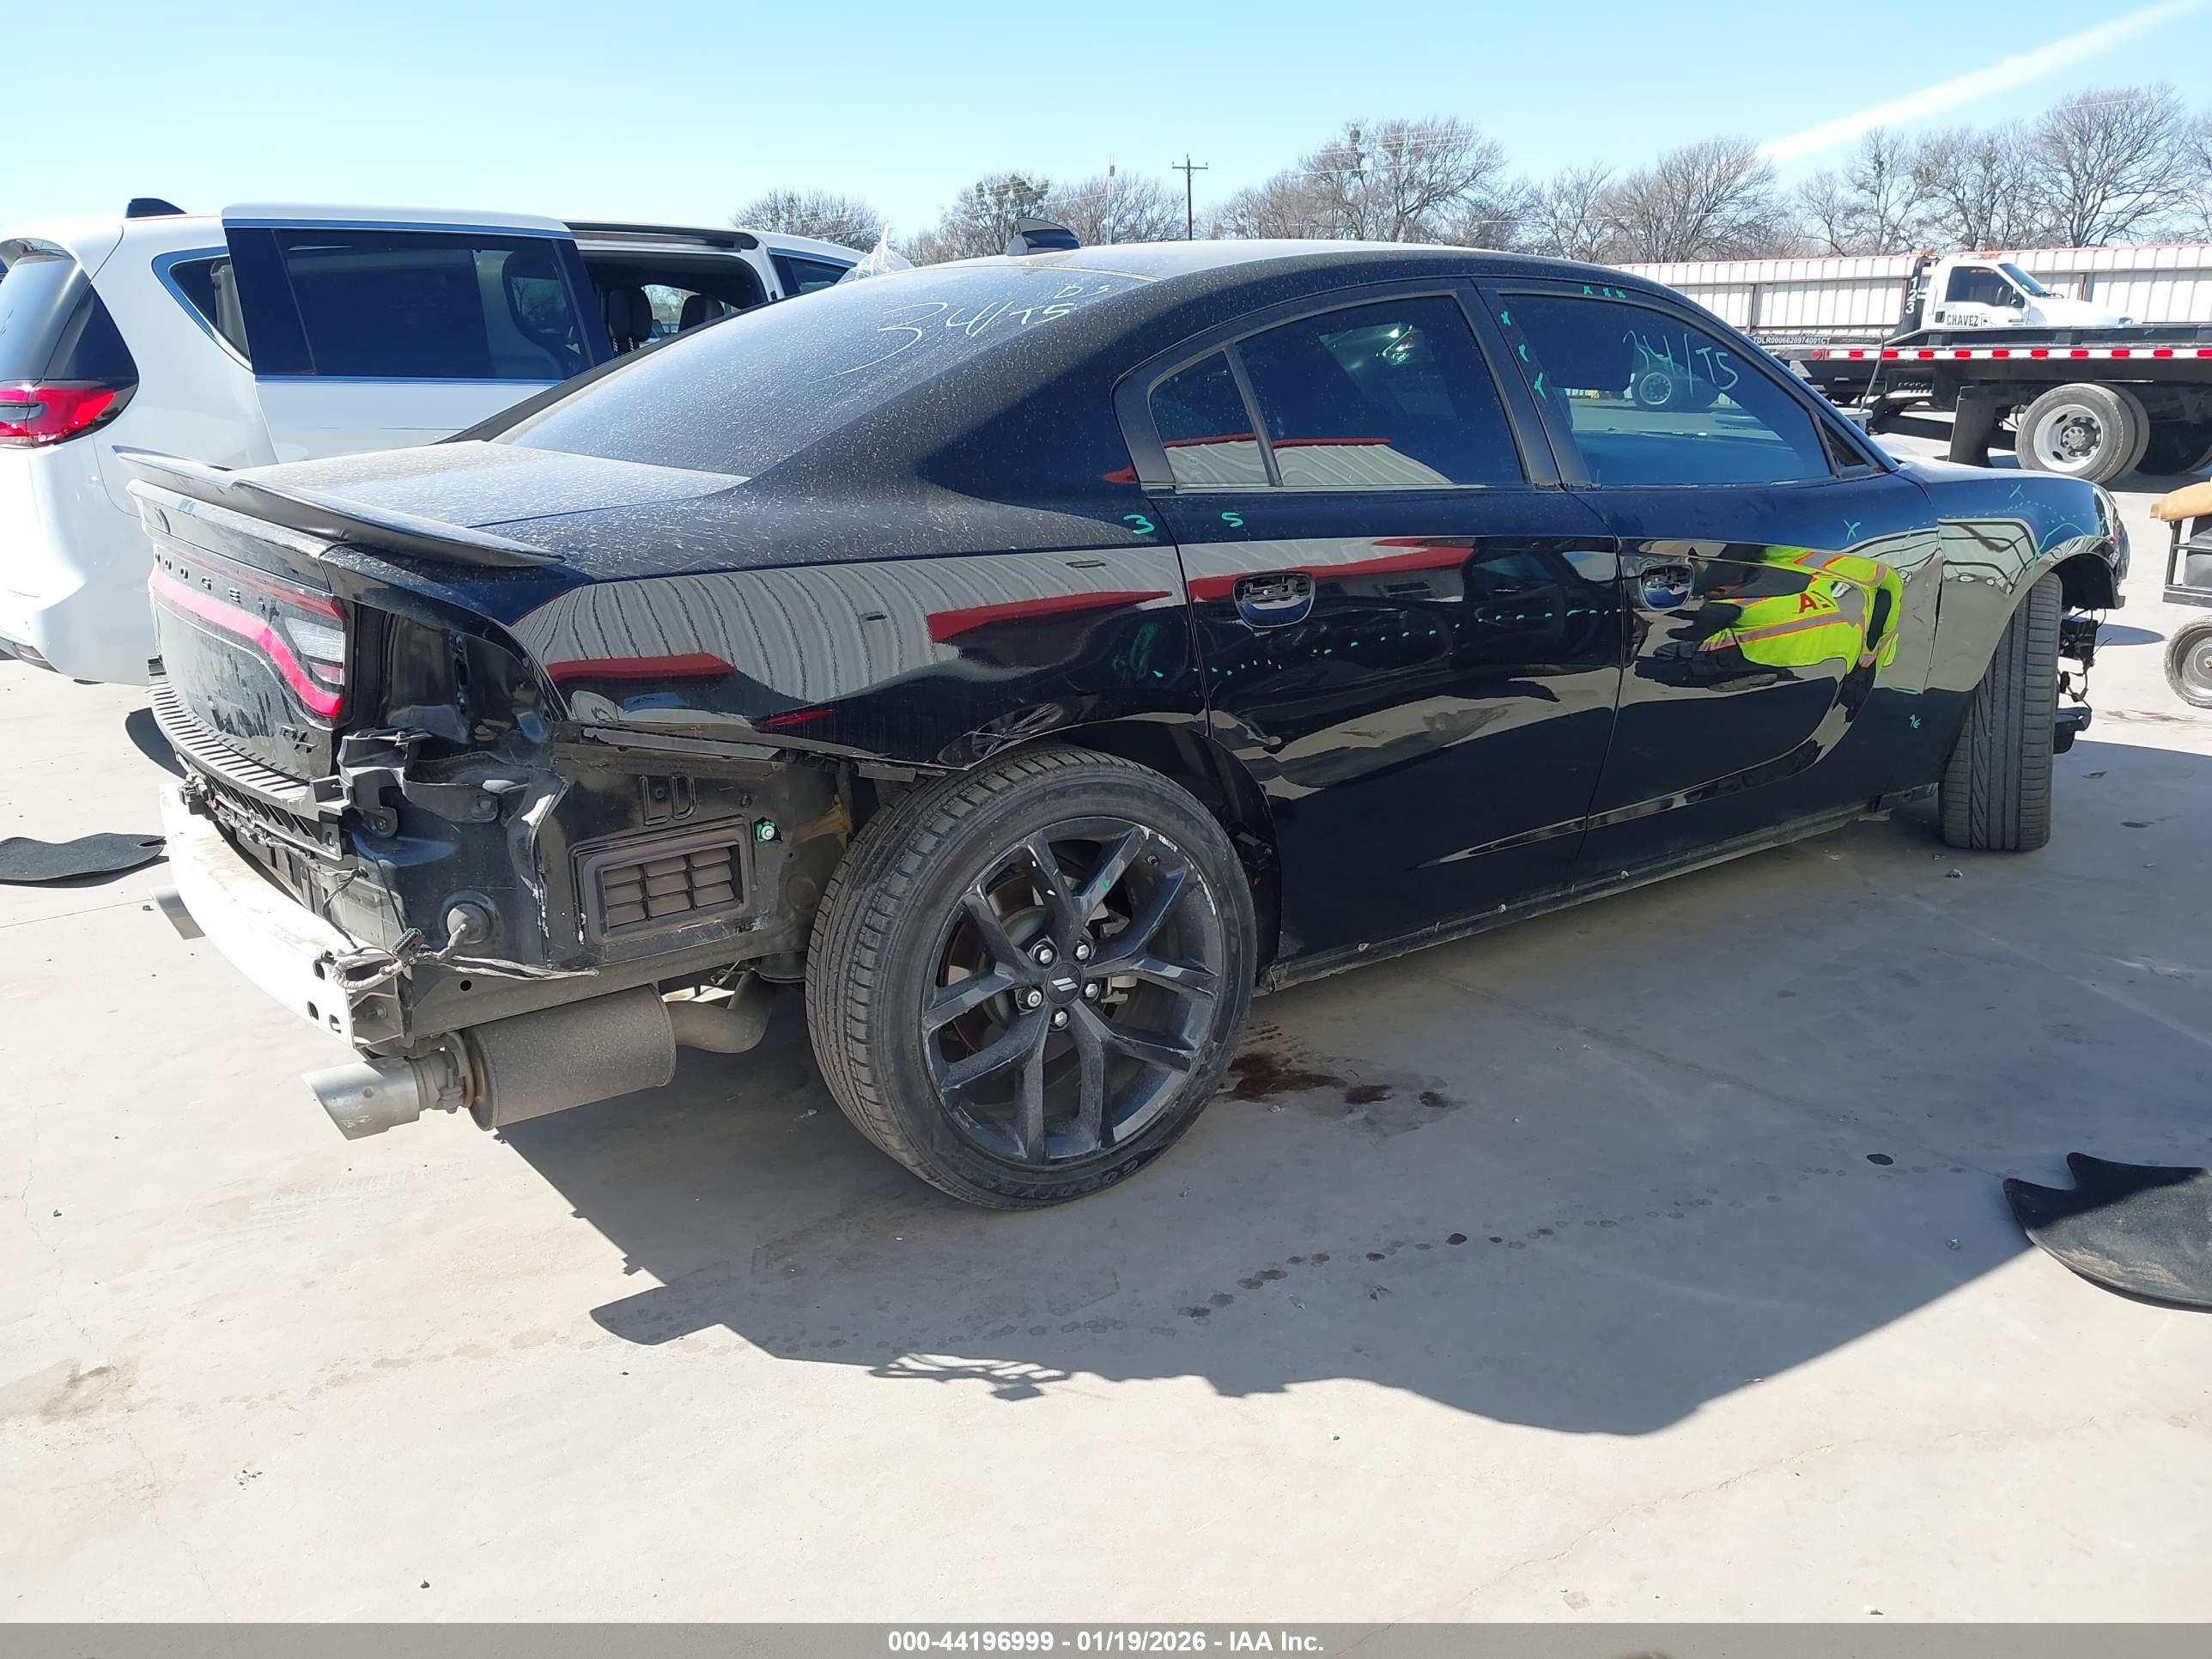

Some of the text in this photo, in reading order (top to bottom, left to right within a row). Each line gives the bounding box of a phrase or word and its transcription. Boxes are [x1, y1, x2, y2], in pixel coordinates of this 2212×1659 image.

[1905, 276, 1918, 314] 123
[1946, 314, 1979, 327] CHAVEZ
[1123, 514, 1155, 535] 3
